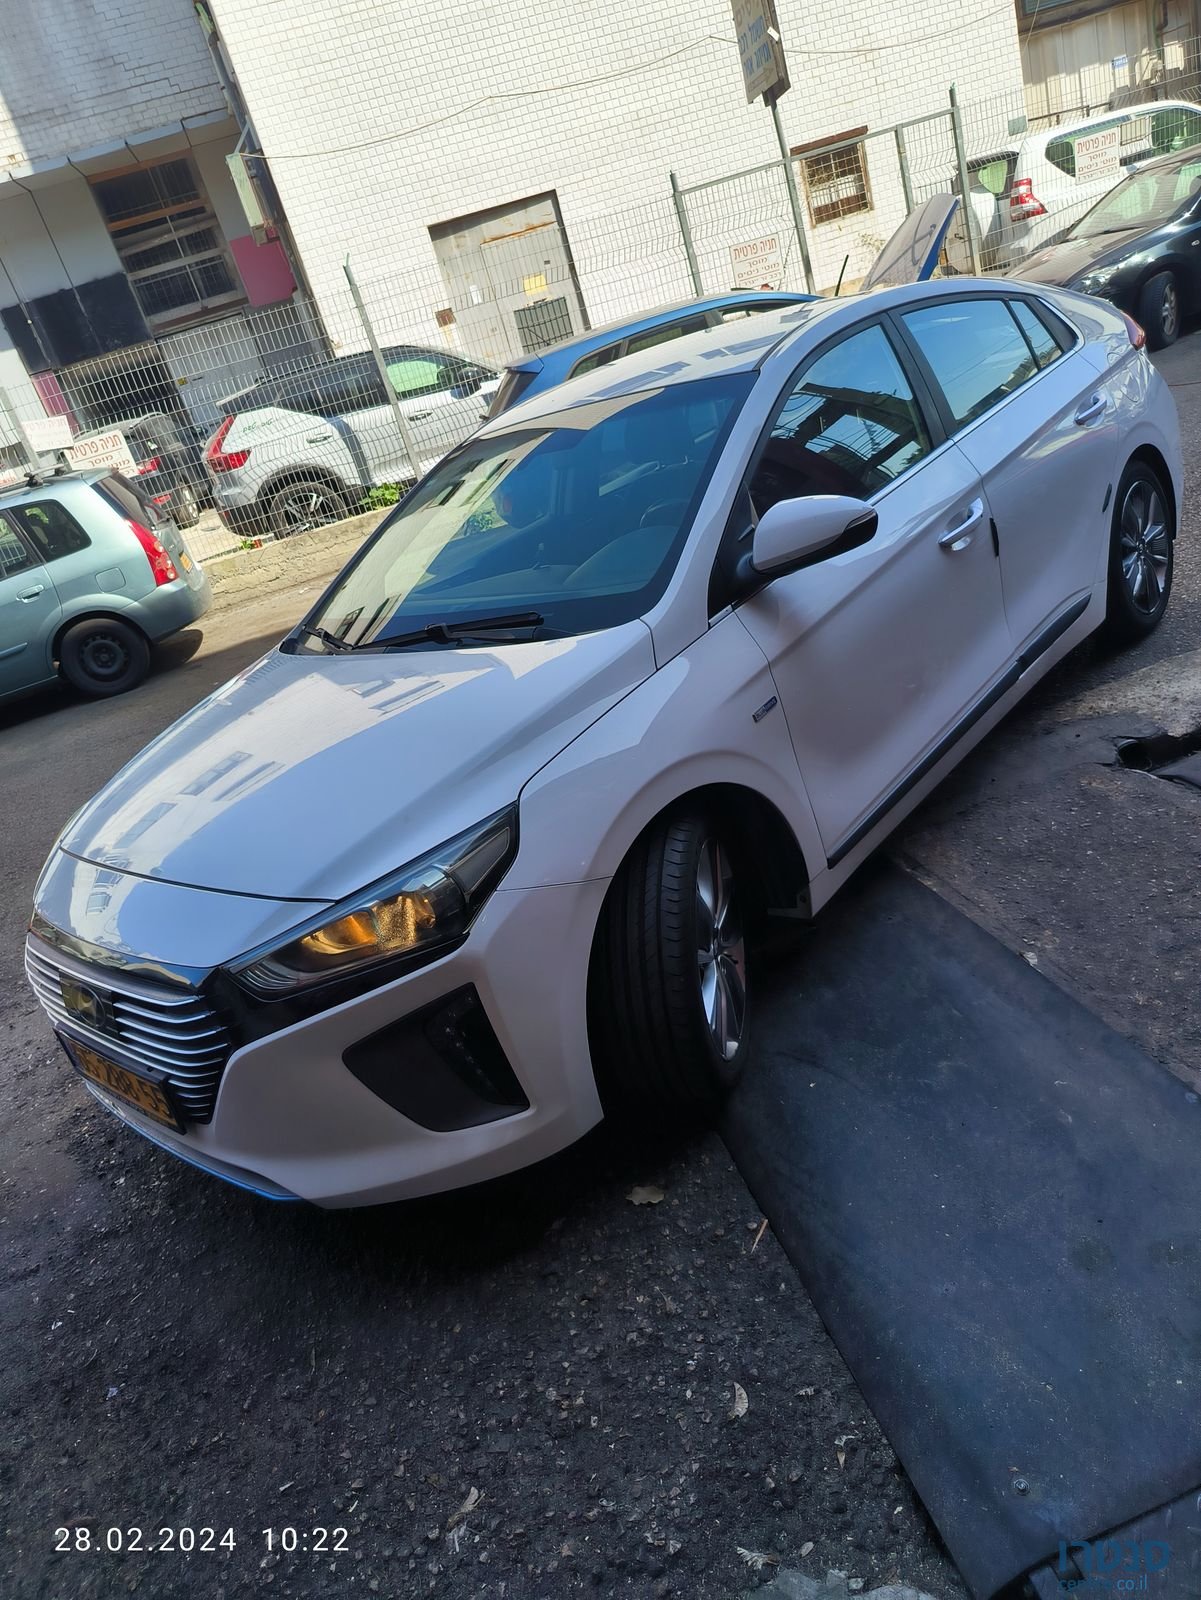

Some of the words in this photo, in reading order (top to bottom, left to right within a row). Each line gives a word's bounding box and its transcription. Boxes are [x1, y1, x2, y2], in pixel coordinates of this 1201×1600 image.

[1077, 137, 1100, 154] פרטית
[1101, 132, 1116, 146] חניה
[1088, 151, 1107, 162] מוסך
[733, 243, 758, 260] פרטית
[760, 238, 777, 253] חניה
[748, 257, 768, 268] מוסך
[101, 434, 122, 450] חניה
[70, 440, 99, 460] פרטית
[90, 454, 114, 468] מוסך
